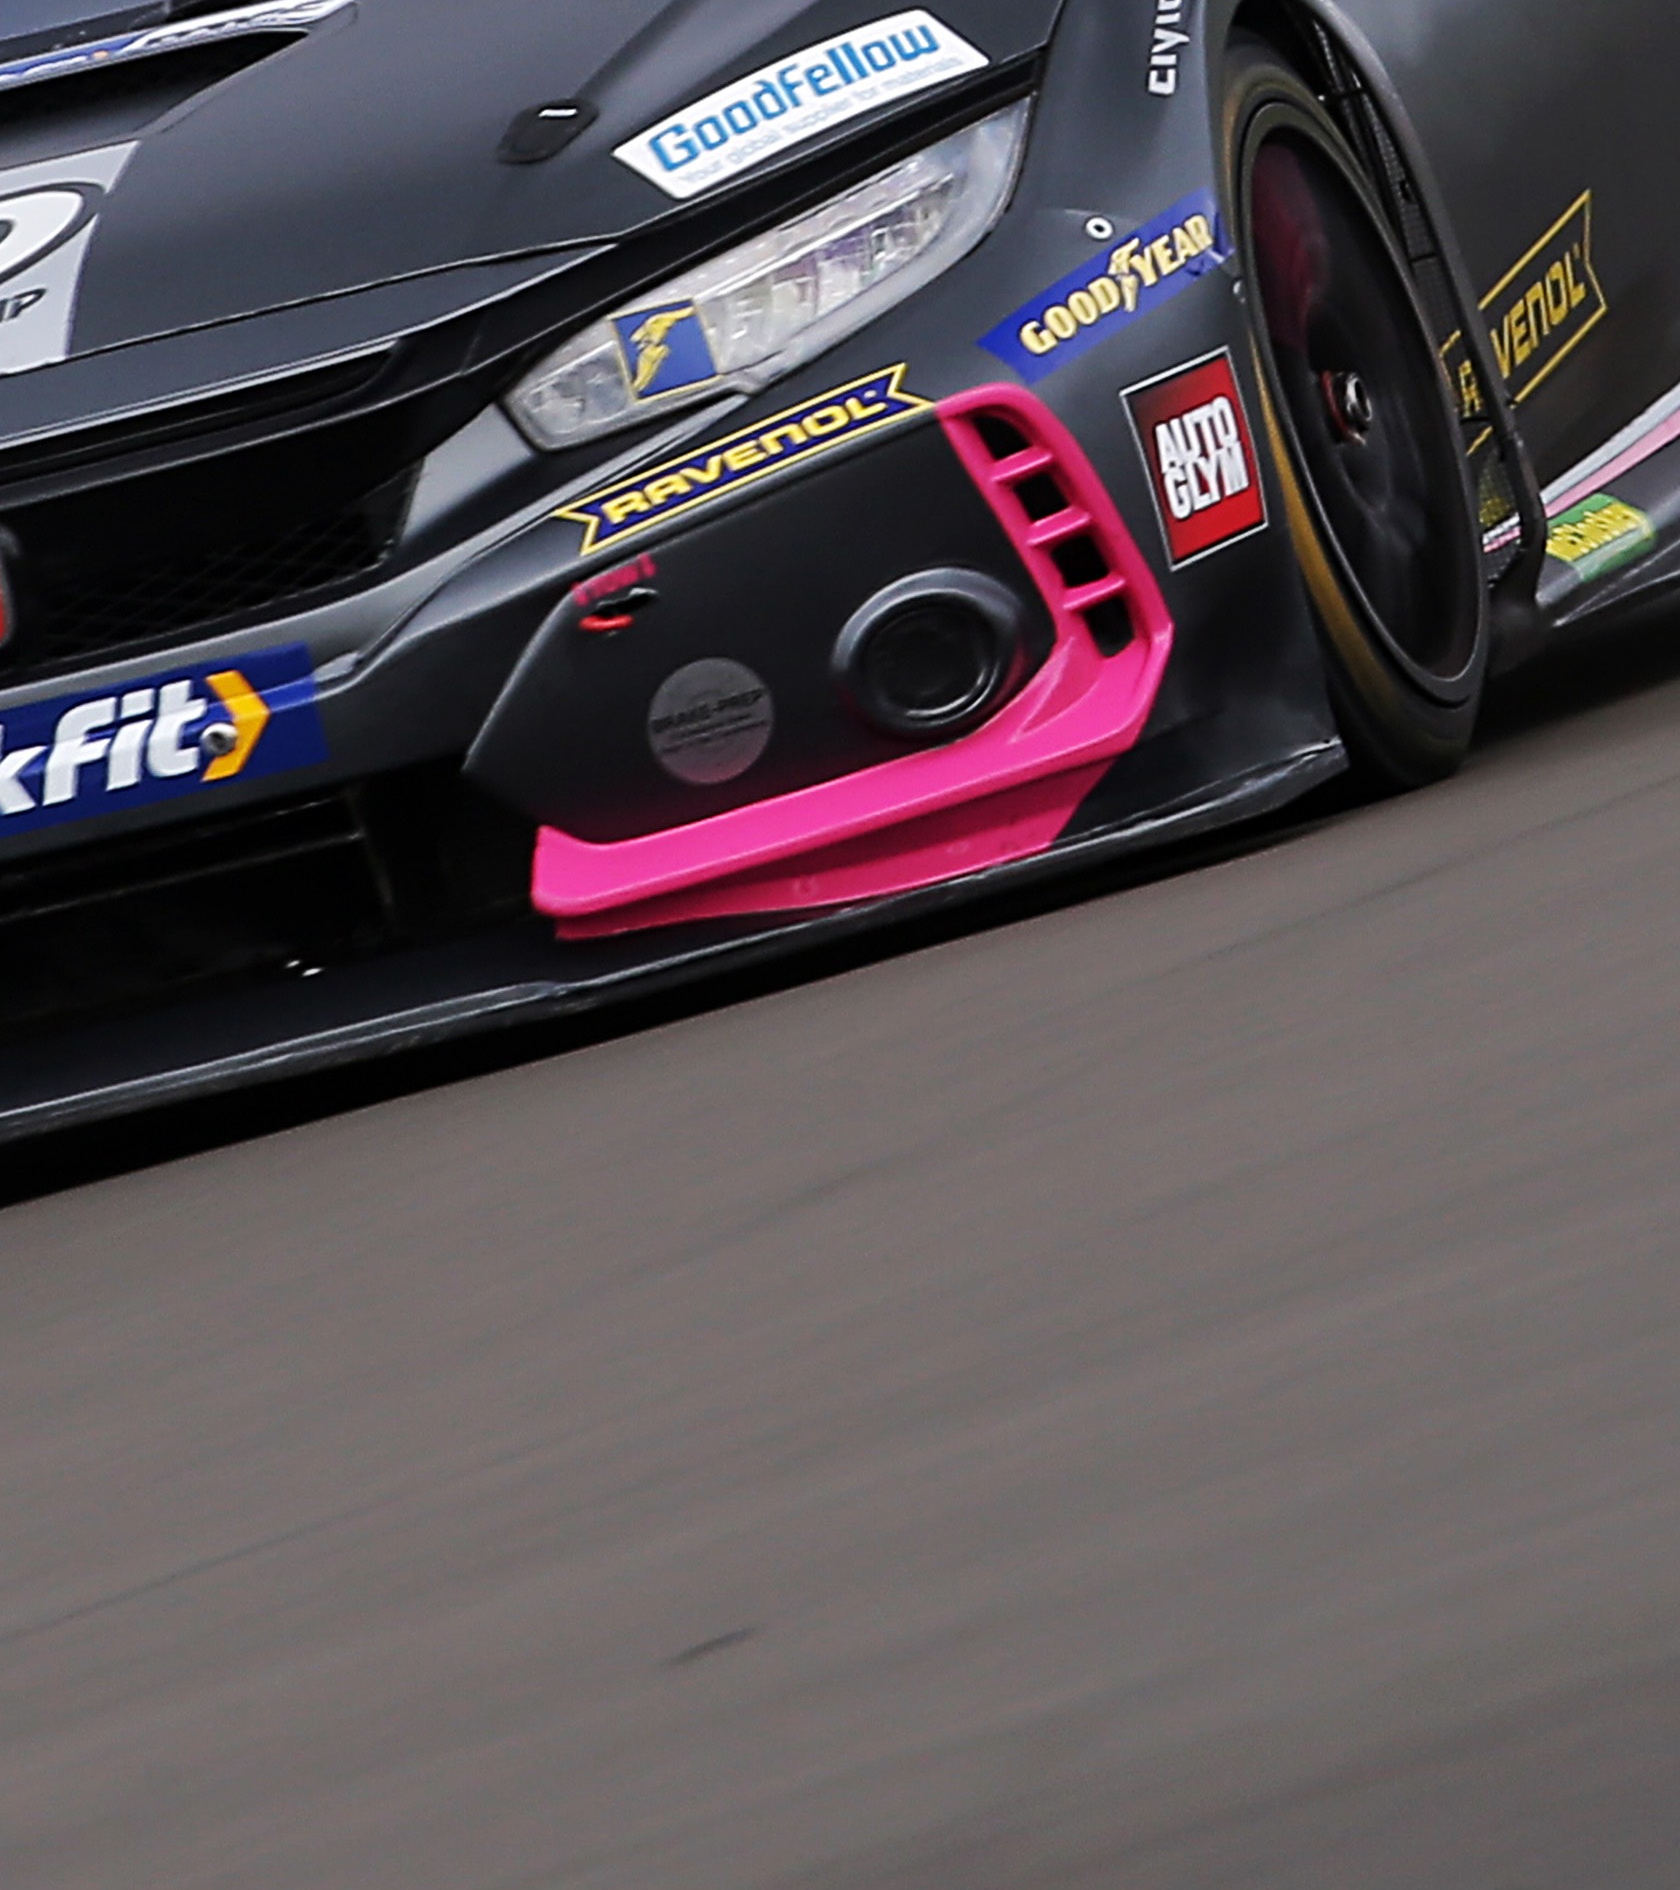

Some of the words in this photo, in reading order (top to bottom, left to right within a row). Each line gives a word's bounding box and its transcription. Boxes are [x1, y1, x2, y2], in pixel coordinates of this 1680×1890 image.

[603, 392, 887, 525] RAVENOL
[1155, 395, 1238, 474] AUTO
[1164, 440, 1249, 520] GLYM
